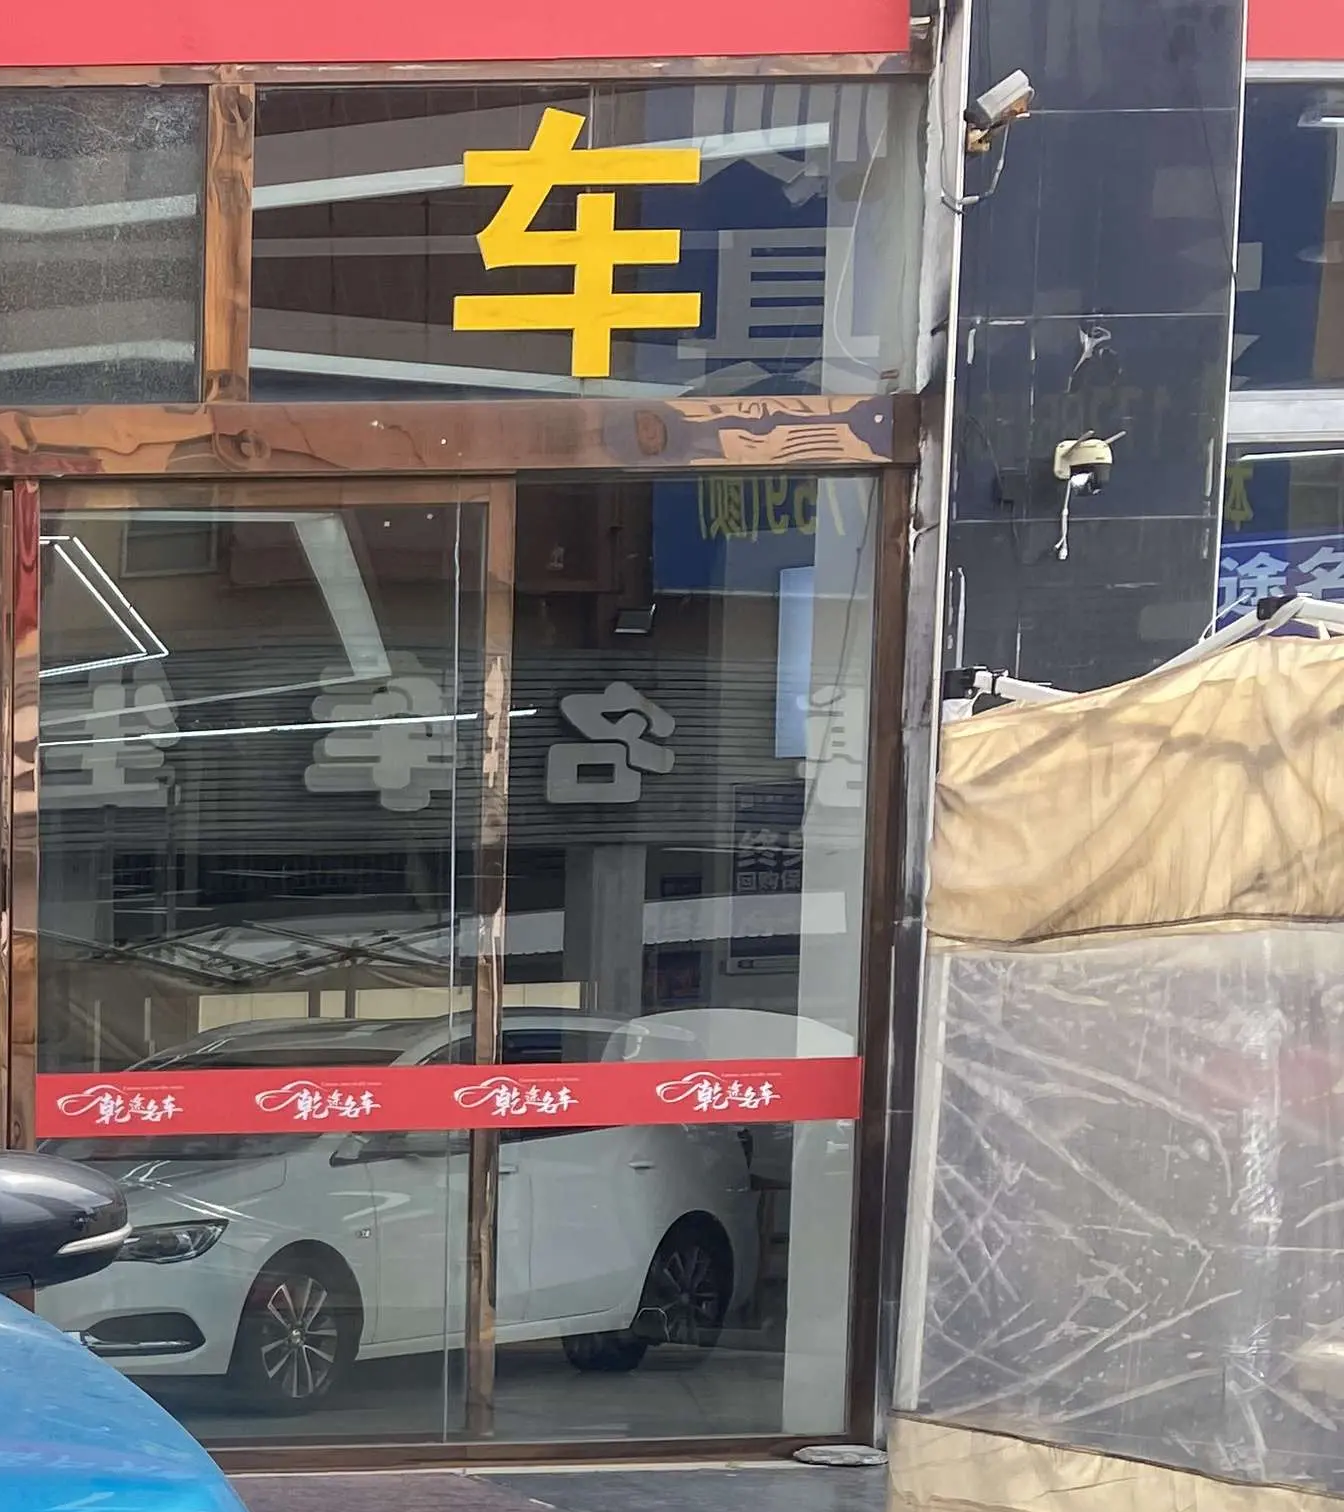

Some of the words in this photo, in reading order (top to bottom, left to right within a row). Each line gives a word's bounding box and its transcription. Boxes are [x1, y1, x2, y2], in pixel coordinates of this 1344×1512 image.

[96, 1092, 183, 1124] 乾途名车
[293, 1087, 381, 1121] 乾途名车
[492, 1083, 578, 1117] 乾途名车
[694, 1079, 780, 1112] 乾途名车
